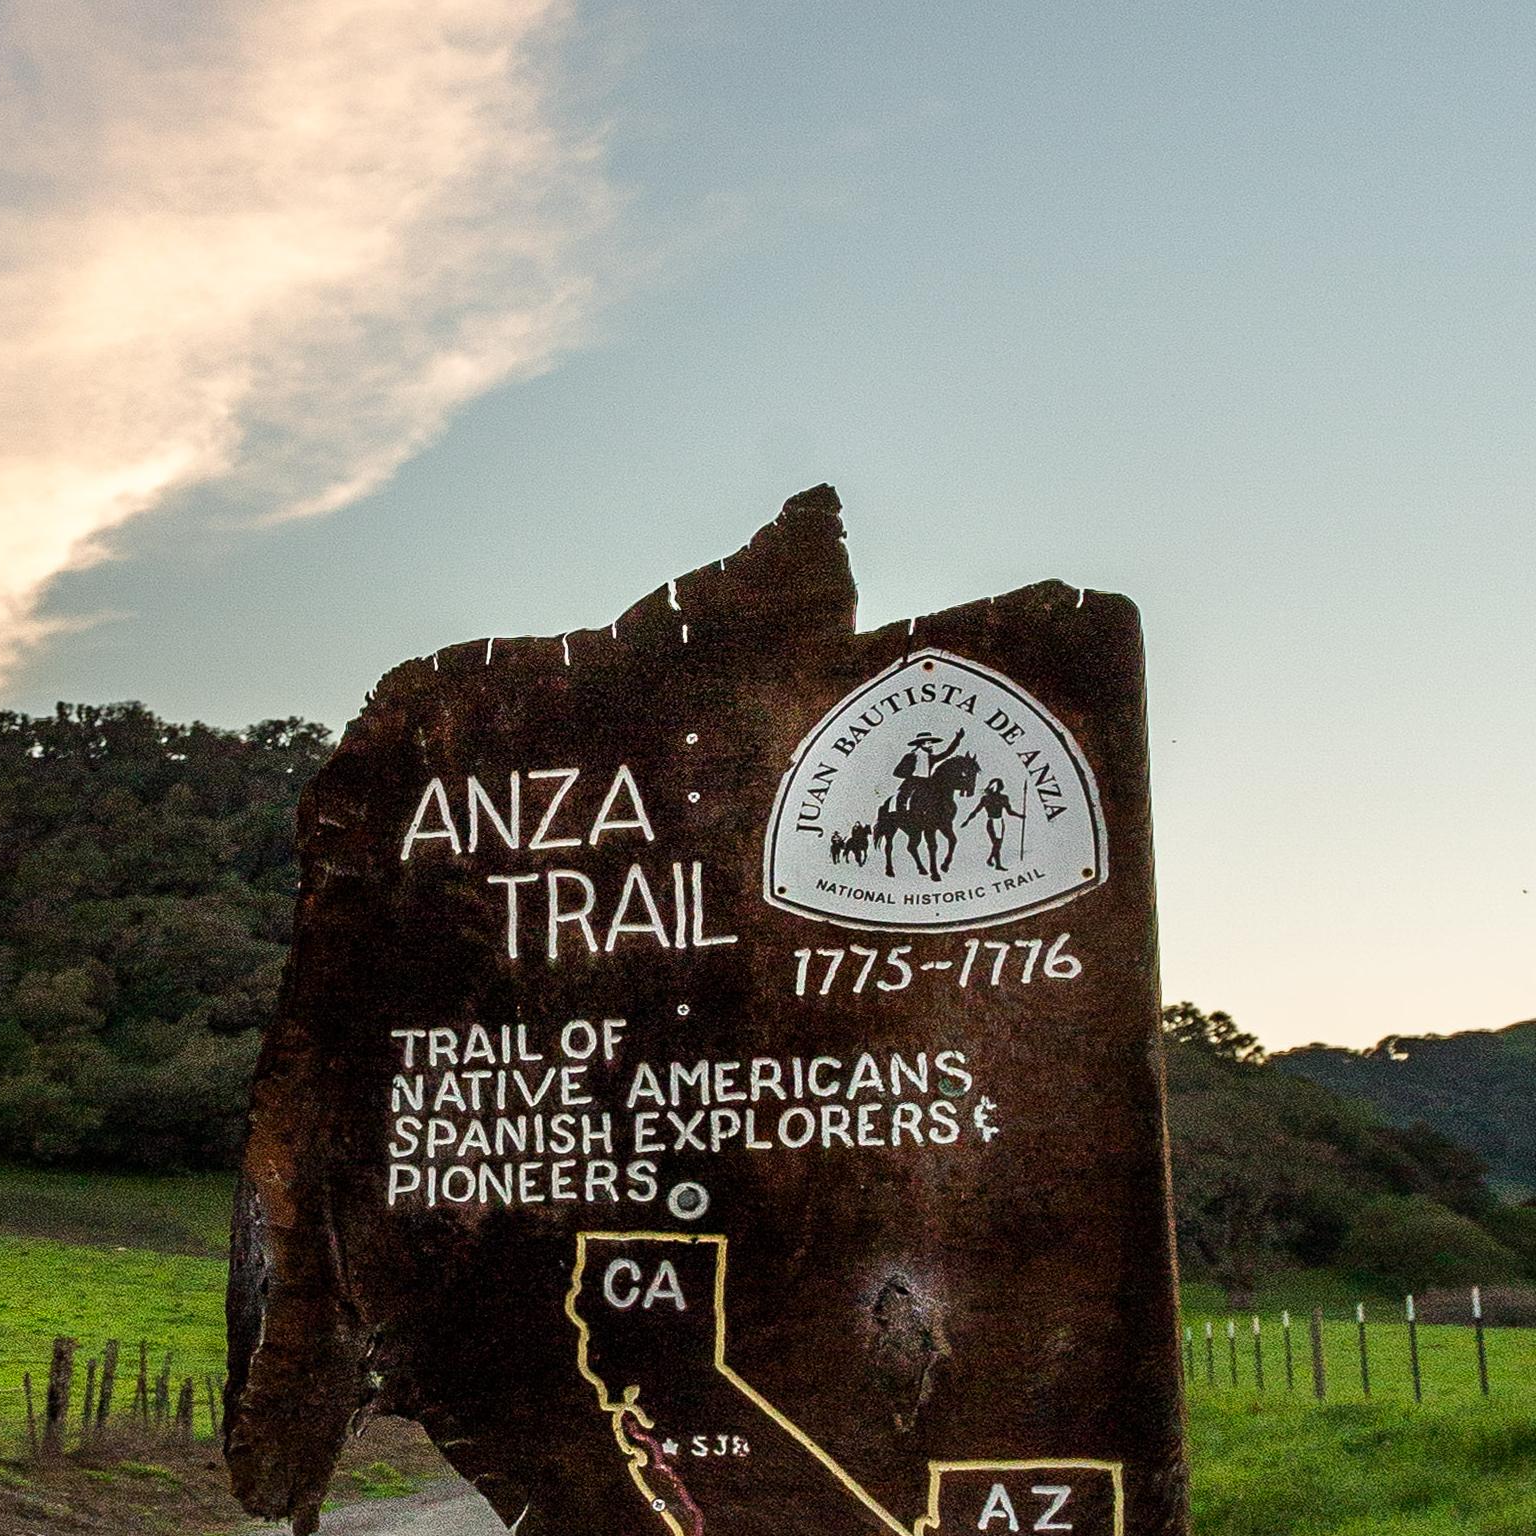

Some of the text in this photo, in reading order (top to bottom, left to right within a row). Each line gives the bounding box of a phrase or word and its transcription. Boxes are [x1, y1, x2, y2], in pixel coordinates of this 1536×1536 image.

[796, 683, 1068, 838] JUAN BAUTISTA DE ANZA
[400, 763, 655, 862] ANZA
[487, 860, 738, 960] TRAIL
[816, 868, 1046, 905] NATIONAL HISTORIC TRAIL
[794, 932, 1083, 996] 1775-1776
[390, 1018, 627, 1068] TRAIL OF
[390, 1050, 973, 1112] NATIVE AMERICANS
[388, 1115, 612, 1159] SPANISH
[634, 1100, 960, 1153] EXPLORERS
[388, 1160, 658, 1206] PIONEERS
[602, 1257, 687, 1311] CA
